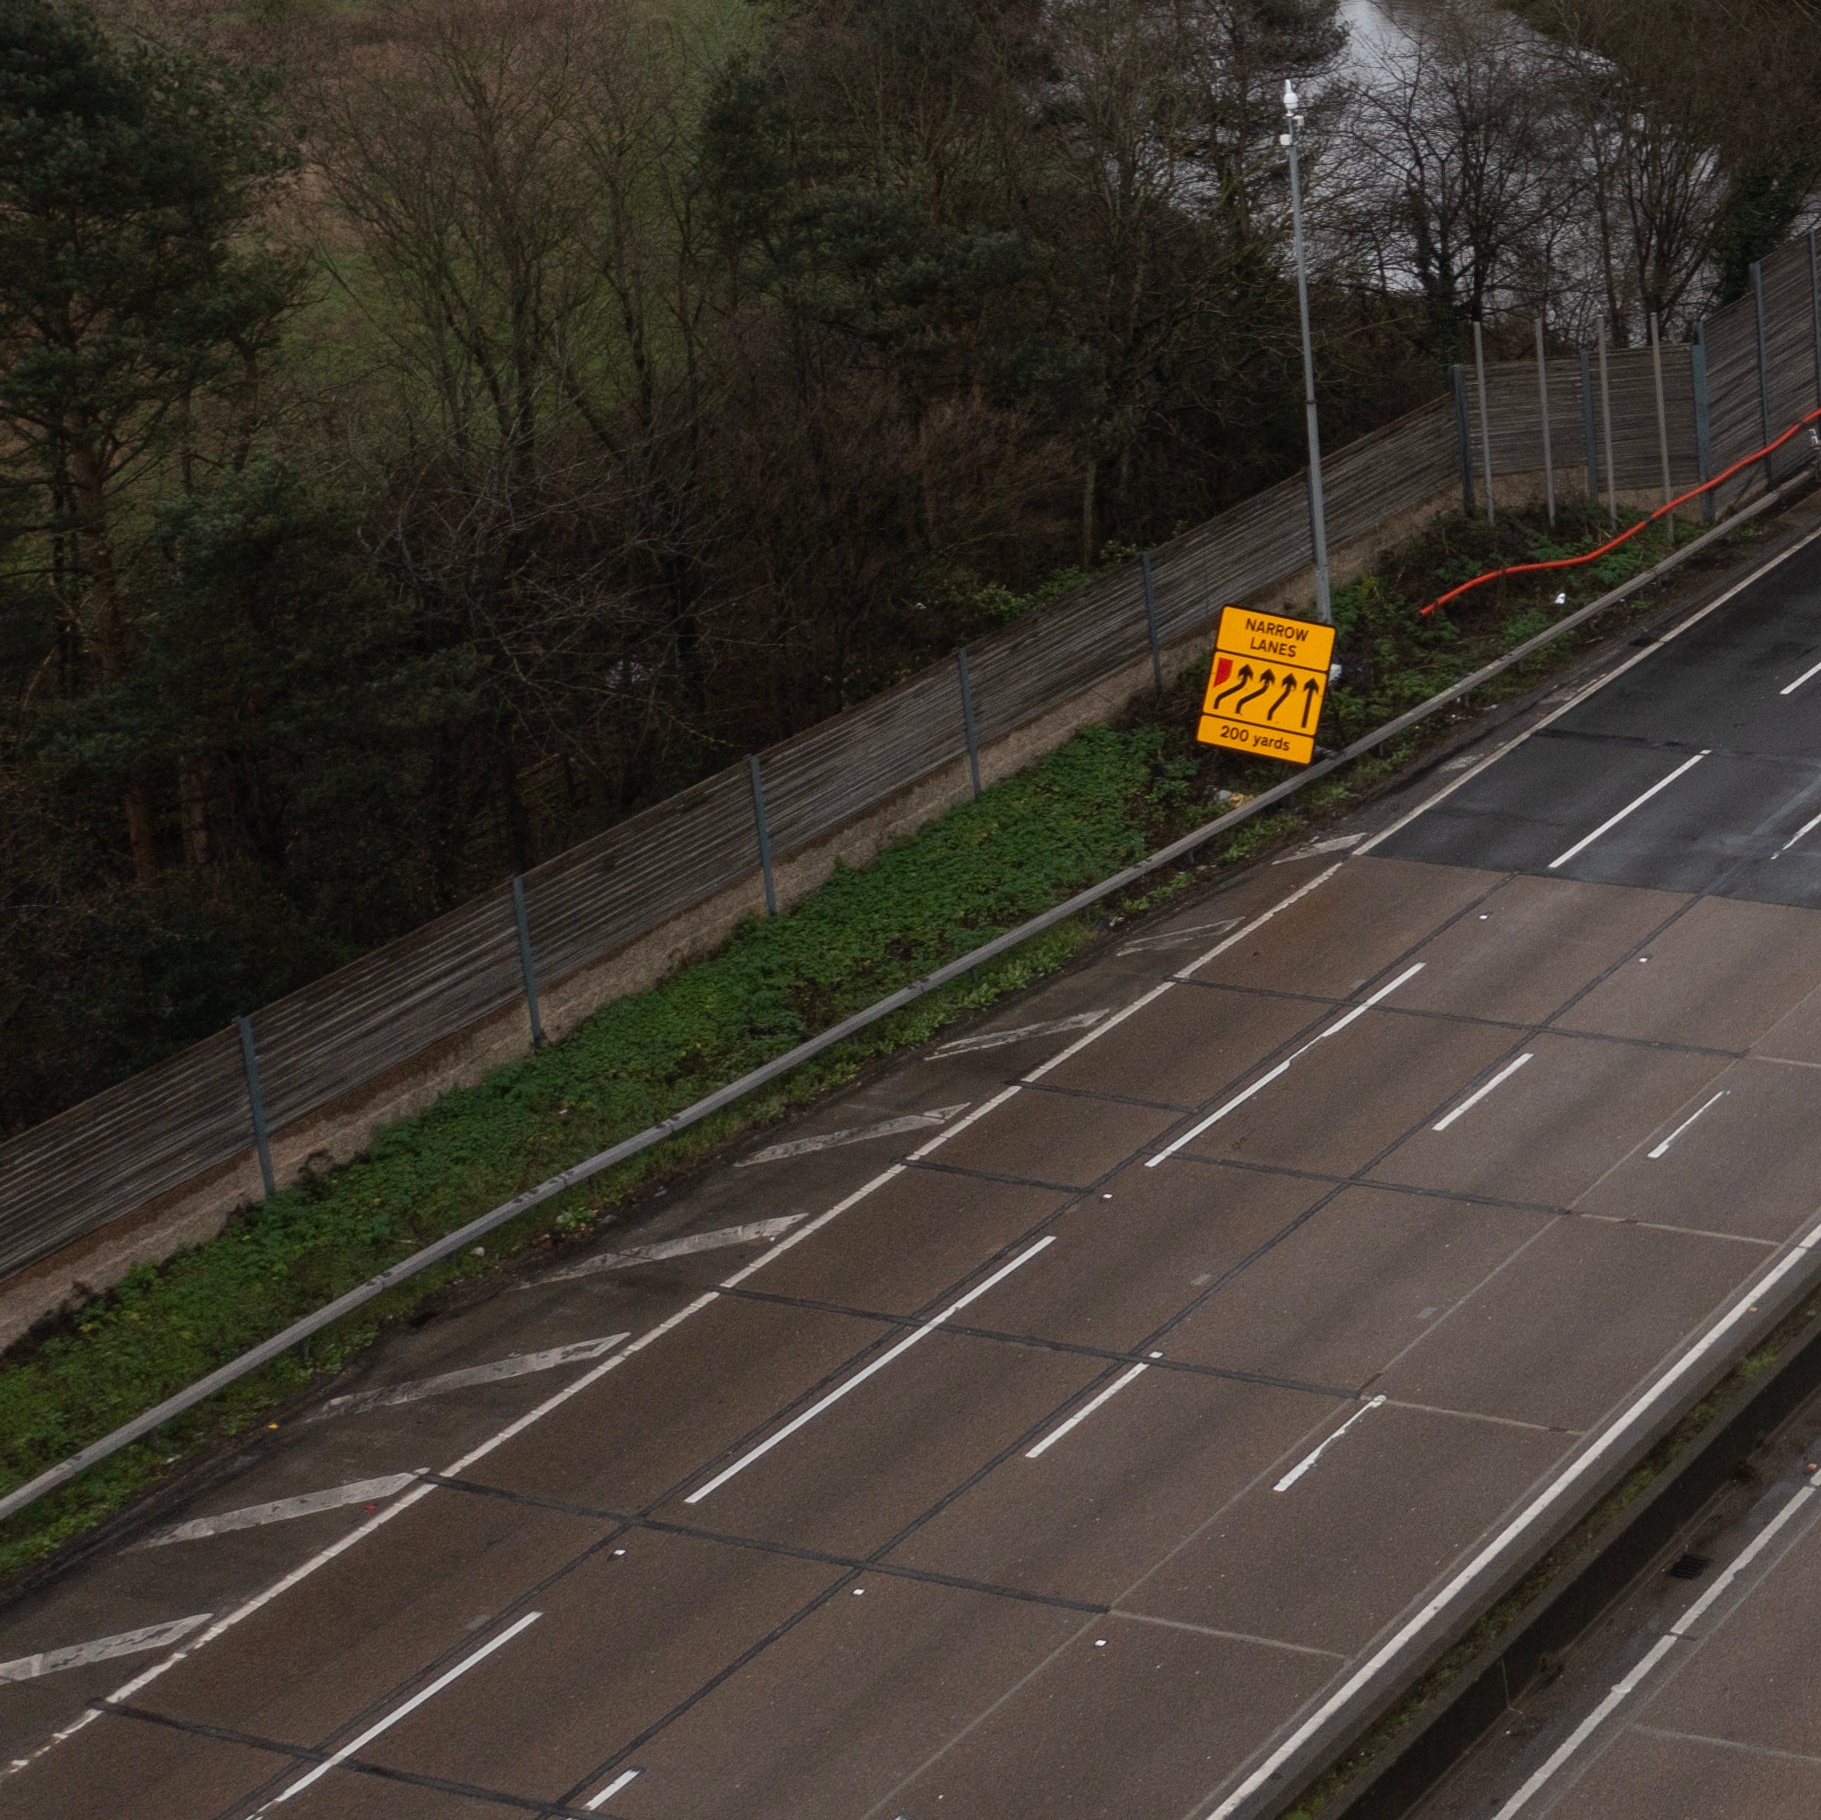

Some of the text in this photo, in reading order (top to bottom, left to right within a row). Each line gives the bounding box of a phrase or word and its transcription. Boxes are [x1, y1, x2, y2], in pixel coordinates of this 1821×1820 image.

[1245, 617, 1309, 642] NARROW
[1249, 637, 1297, 658] LANES
[1220, 725, 1290, 751] 200 yards
